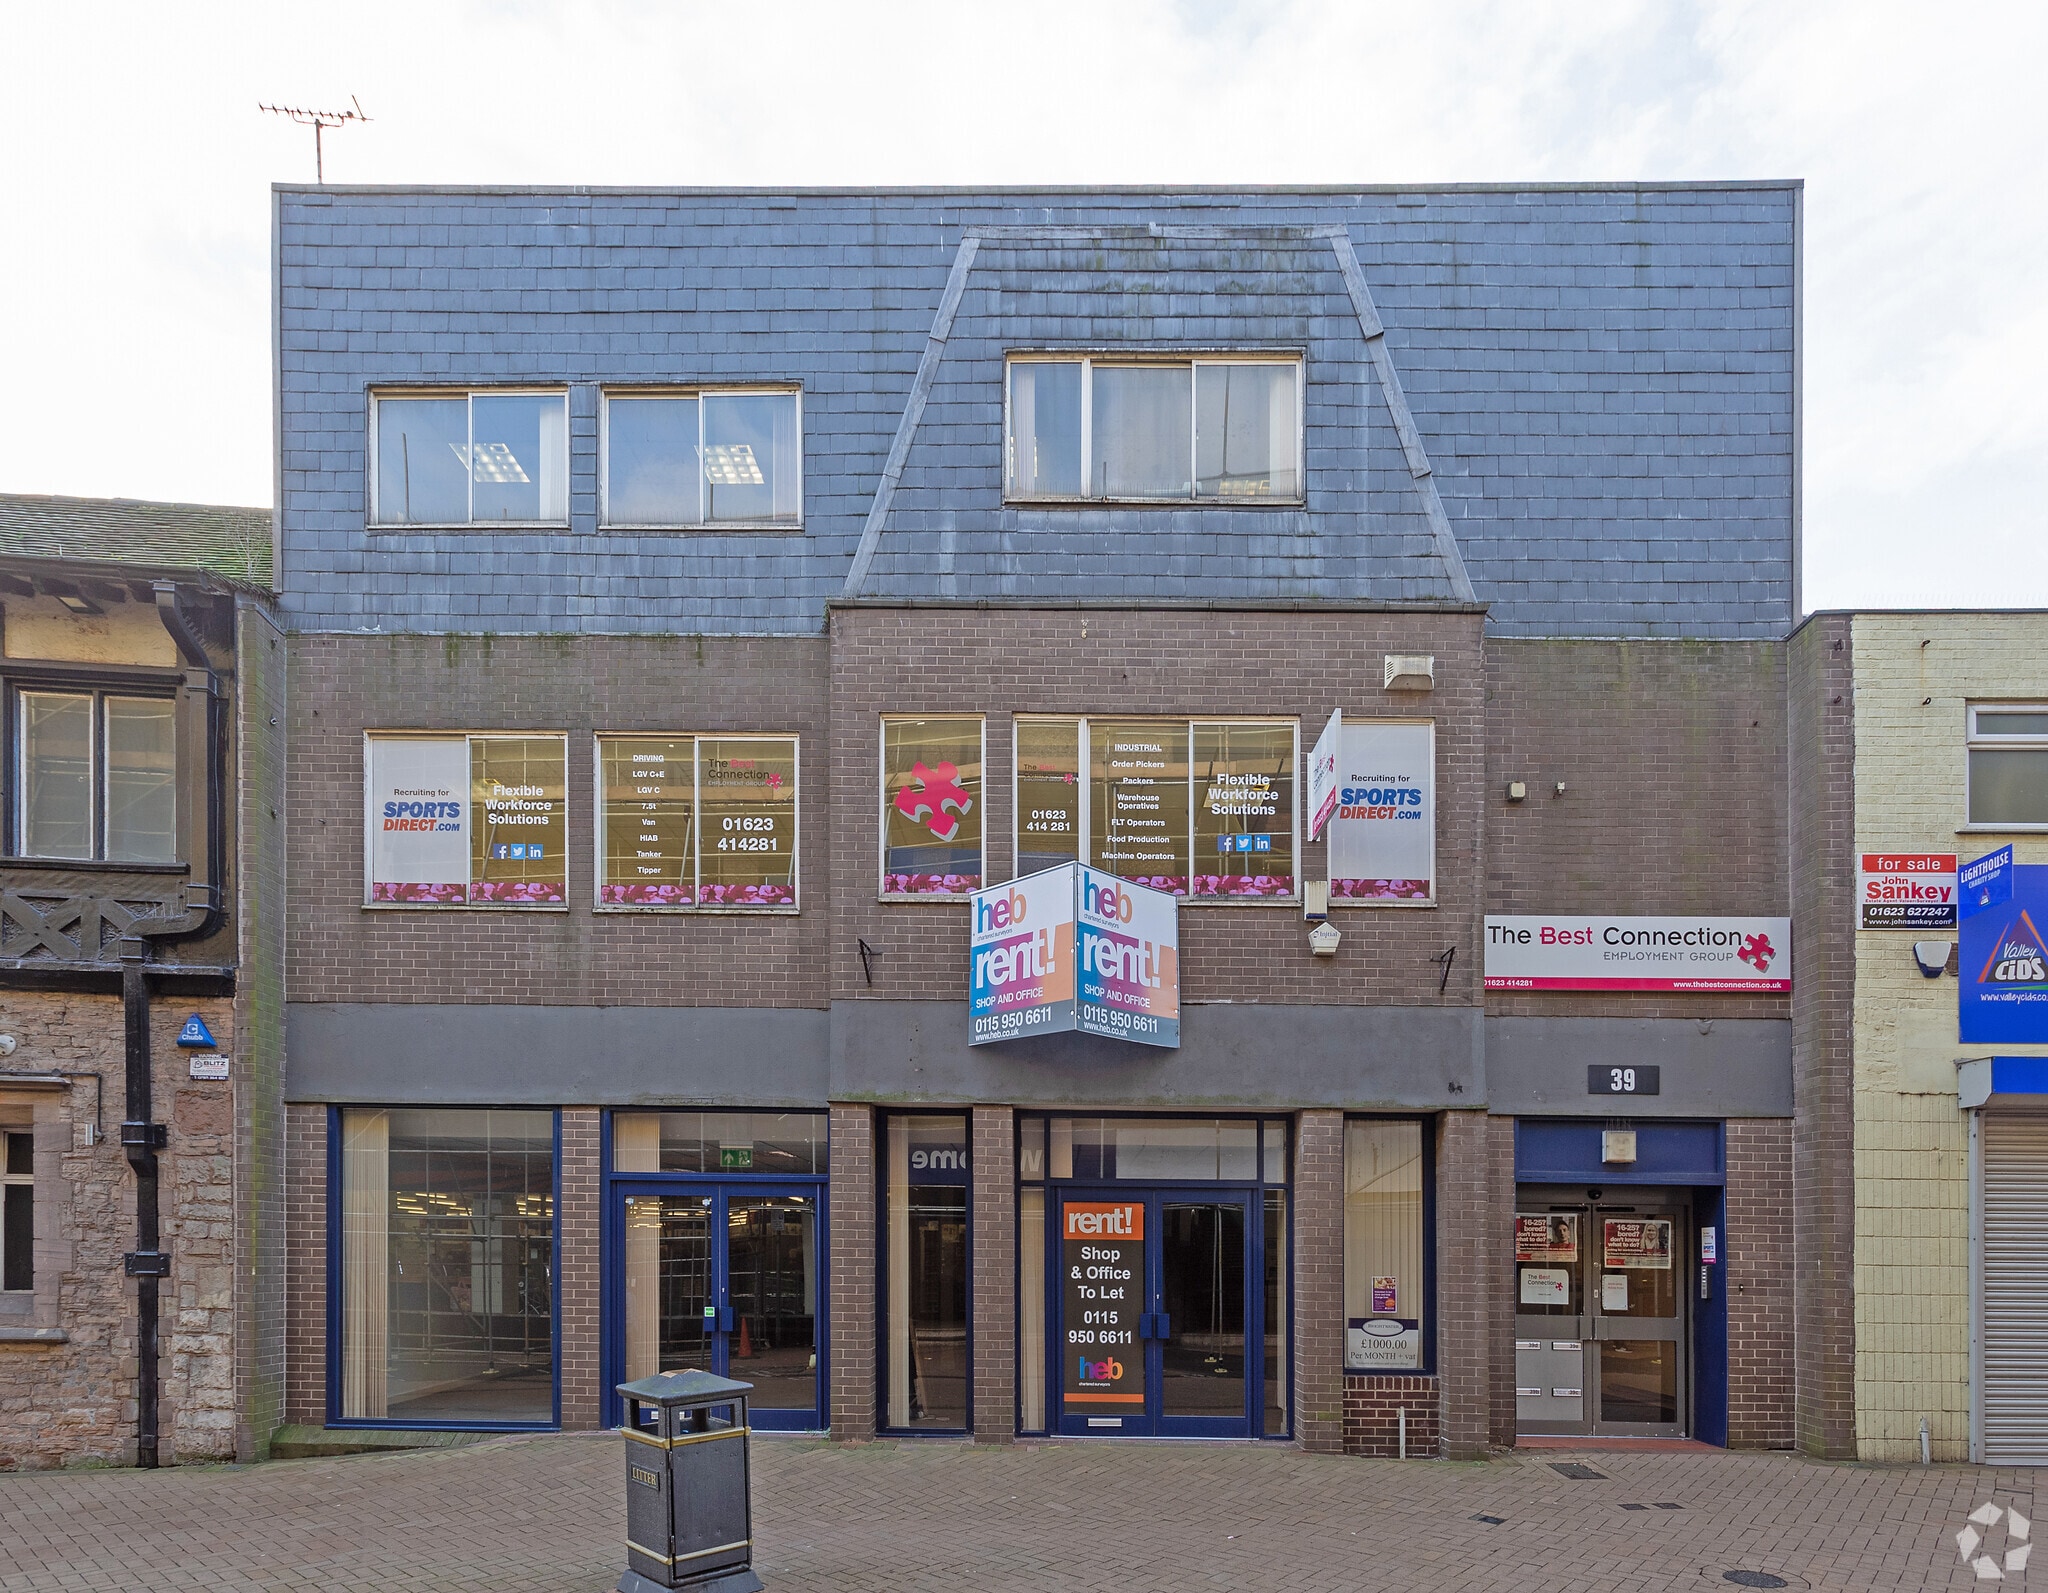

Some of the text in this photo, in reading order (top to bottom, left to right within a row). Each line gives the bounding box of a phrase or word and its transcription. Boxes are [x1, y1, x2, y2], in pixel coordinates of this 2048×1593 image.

[1114, 744, 1162, 752] INDUSTRIAL
[708, 759, 755, 768] The Best
[708, 769, 770, 779] Connection
[1217, 774, 1270, 785] Flexible
[1351, 775, 1396, 784] Recruiting
[394, 789, 436, 798] Recruiting
[493, 785, 544, 796] Flexible
[1208, 788, 1279, 800] Workforce
[1341, 788, 1422, 806] SPORTS
[383, 801, 460, 818] SPORTS
[485, 799, 552, 811] Workforce
[1117, 802, 1159, 810] Operatives
[1211, 803, 1276, 815] Solutions
[488, 813, 549, 825] Solutions
[1032, 810, 1066, 819] 01623
[1340, 806, 1421, 820] DIRECT.COM
[383, 819, 460, 832] DIRECT.COM
[722, 817, 774, 831] 01623
[1026, 822, 1070, 831] 414 281
[1127, 819, 1166, 827] Operators
[717, 837, 777, 851] 414281
[1877, 857, 1941, 870] for sale
[1881, 876, 1908, 885] John
[1084, 871, 1133, 923] heb
[1866, 882, 1952, 903] Sankey
[977, 887, 1027, 934] heb
[1869, 907, 1950, 916] 01623 627247
[1868, 918, 1951, 926] www.johnsankey.com
[1488, 926, 1742, 946] The Best Connection
[1603, 951, 1734, 961] EMPLOYMENT GROUP
[2003, 940, 2038, 961] Valley
[976, 927, 1057, 989] rent!
[1083, 932, 1161, 989] rent!
[1673, 981, 1782, 989] www.thebestconnection.co.uk
[976, 987, 1044, 1008] SHOP AND OFFICE
[1084, 983, 1151, 1008] SHOP AND OFFICE
[975, 1006, 1052, 1033] 0115 950 6611
[1084, 1004, 1158, 1033] 0115 950 6611
[975, 1027, 1020, 1041] www.heb.co.uk
[1083, 1021, 1128, 1037] www.heb.co.uk
[1610, 1068, 1635, 1091] 39
[1068, 1207, 1133, 1234] rent!
[1081, 1246, 1121, 1263] Shop
[1070, 1265, 1131, 1280] & Office
[1078, 1285, 1124, 1299] To Let
[1084, 1311, 1118, 1324] 0115
[1068, 1330, 1132, 1344] 950 6611
[1360, 1339, 1407, 1350] £1000.00
[1350, 1352, 1363, 1360] Per
[1364, 1352, 1396, 1360] MONTH
[1079, 1356, 1124, 1379] heb
[632, 1467, 657, 1486] LITTER
